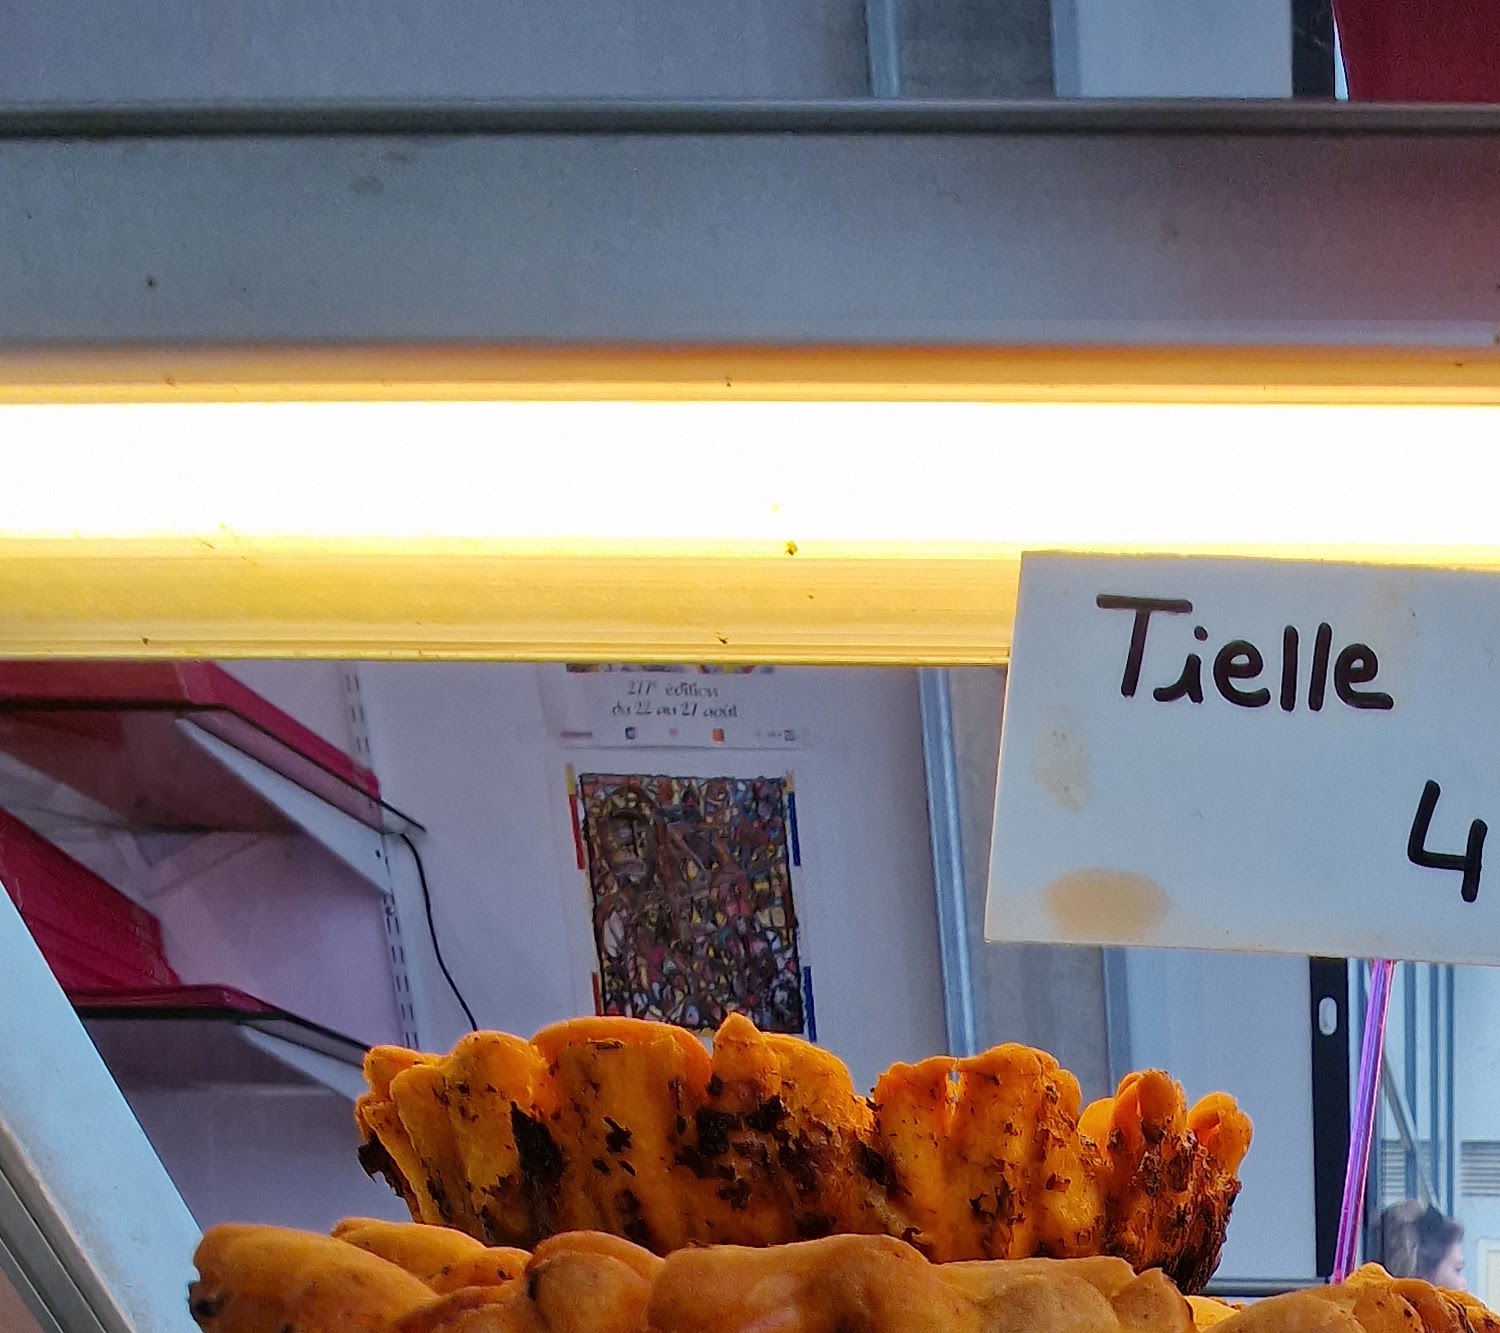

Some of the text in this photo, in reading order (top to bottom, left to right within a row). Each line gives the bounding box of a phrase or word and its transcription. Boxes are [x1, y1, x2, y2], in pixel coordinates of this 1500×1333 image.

[1096, 594, 1395, 713] Tielle
[612, 702, 630, 716] du
[635, 702, 651, 716] 22
[656, 704, 677, 716] au
